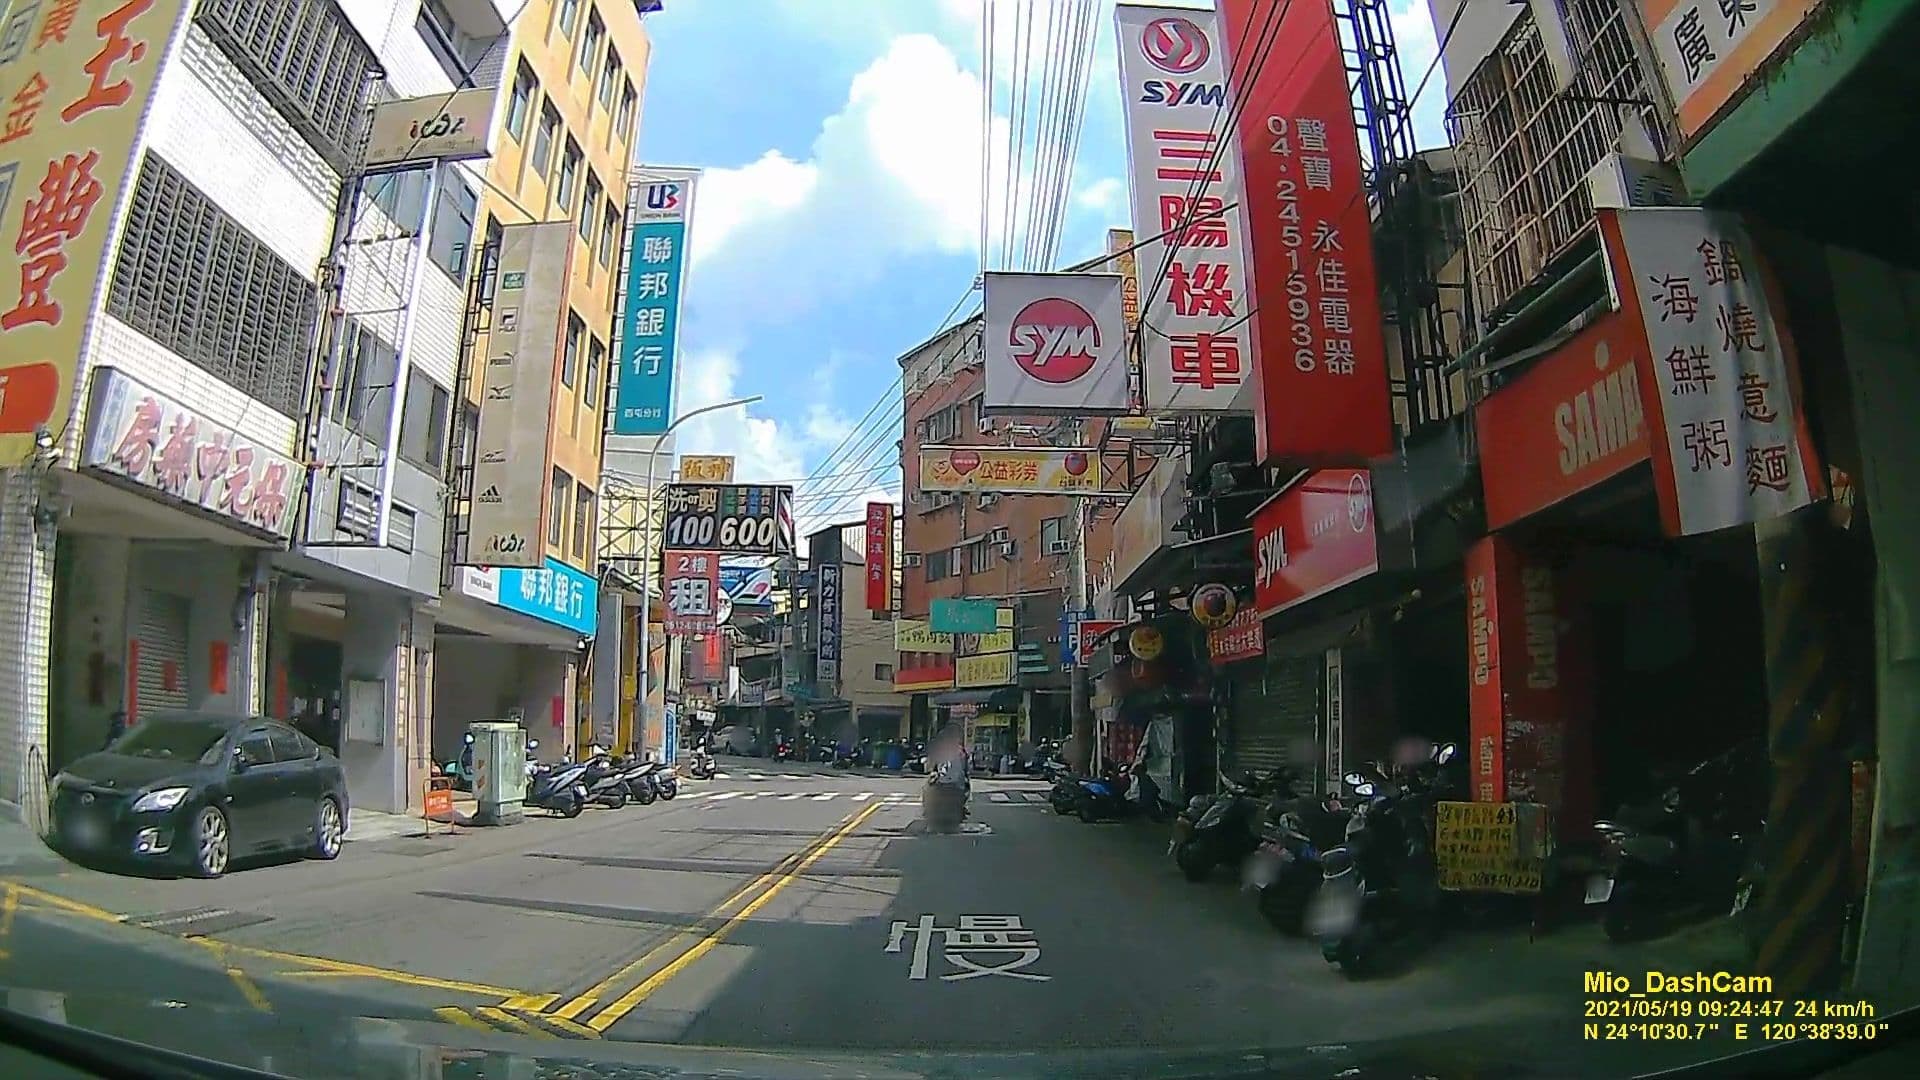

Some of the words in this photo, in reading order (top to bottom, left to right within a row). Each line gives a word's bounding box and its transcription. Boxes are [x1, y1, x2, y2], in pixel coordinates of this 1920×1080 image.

[1140, 80, 1227, 106] SYM
[1296, 117, 1333, 192] 聲寶
[1153, 130, 1241, 389] 三陽機車
[632, 237, 672, 376] 聯邦銀行
[1311, 220, 1355, 376] 永佳電器
[1010, 324, 1101, 366] SYM
[1649, 273, 1732, 473] 海鮮粥
[1696, 238, 1792, 497] 鍋燒意麵
[1554, 341, 1644, 475] SAMP
[979, 460, 1039, 481] 公益彩券
[668, 515, 714, 546] 100
[720, 516, 776, 546] 600
[1255, 526, 1289, 589] SYM
[520, 567, 583, 619] 聯邦銀行
[668, 577, 712, 617] 租
[884, 915, 1053, 981] 慢
